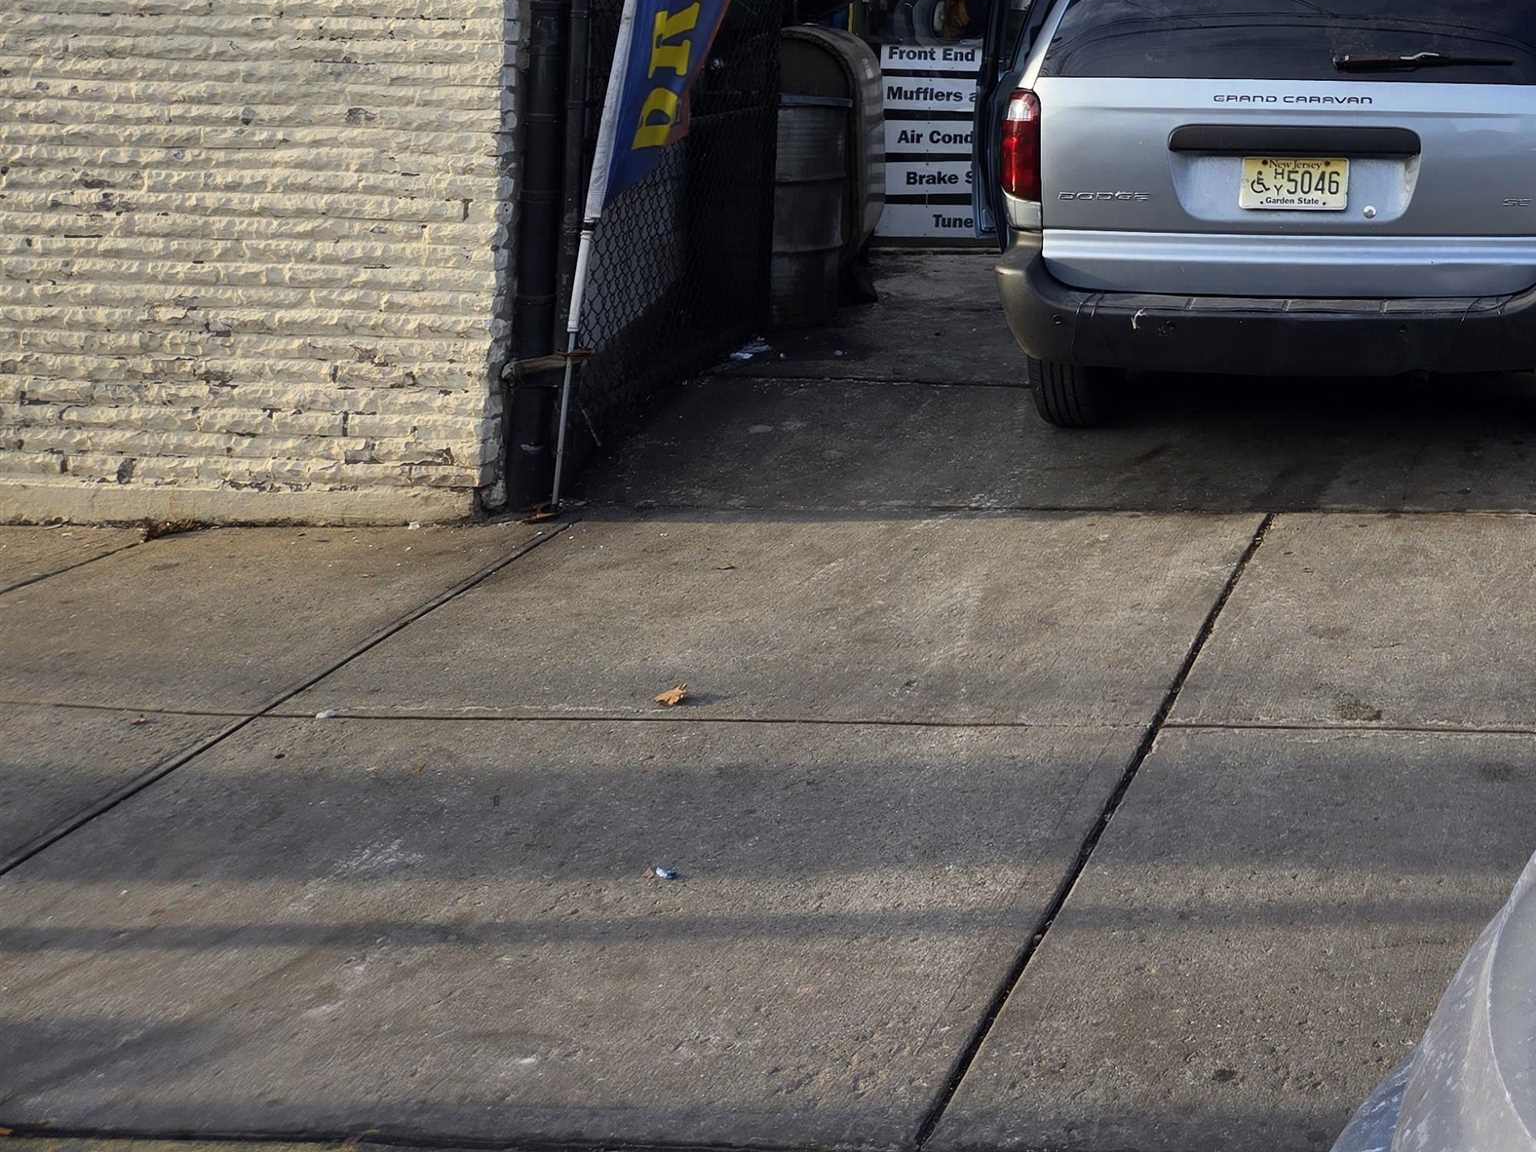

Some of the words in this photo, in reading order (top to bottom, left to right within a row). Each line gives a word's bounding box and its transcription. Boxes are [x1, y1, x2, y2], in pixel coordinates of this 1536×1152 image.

[888, 46, 936, 61] Front
[942, 47, 975, 62] End
[887, 86, 963, 102] Mufflers
[1213, 94, 1278, 103] GRAND
[1283, 95, 1373, 104] CARAVAN
[897, 130, 923, 144] Air
[1269, 160, 1293, 169] New
[1293, 160, 1322, 170] Jersey
[906, 171, 959, 185] Brake
[1265, 196, 1295, 205] Garden
[1297, 197, 1320, 205] State
